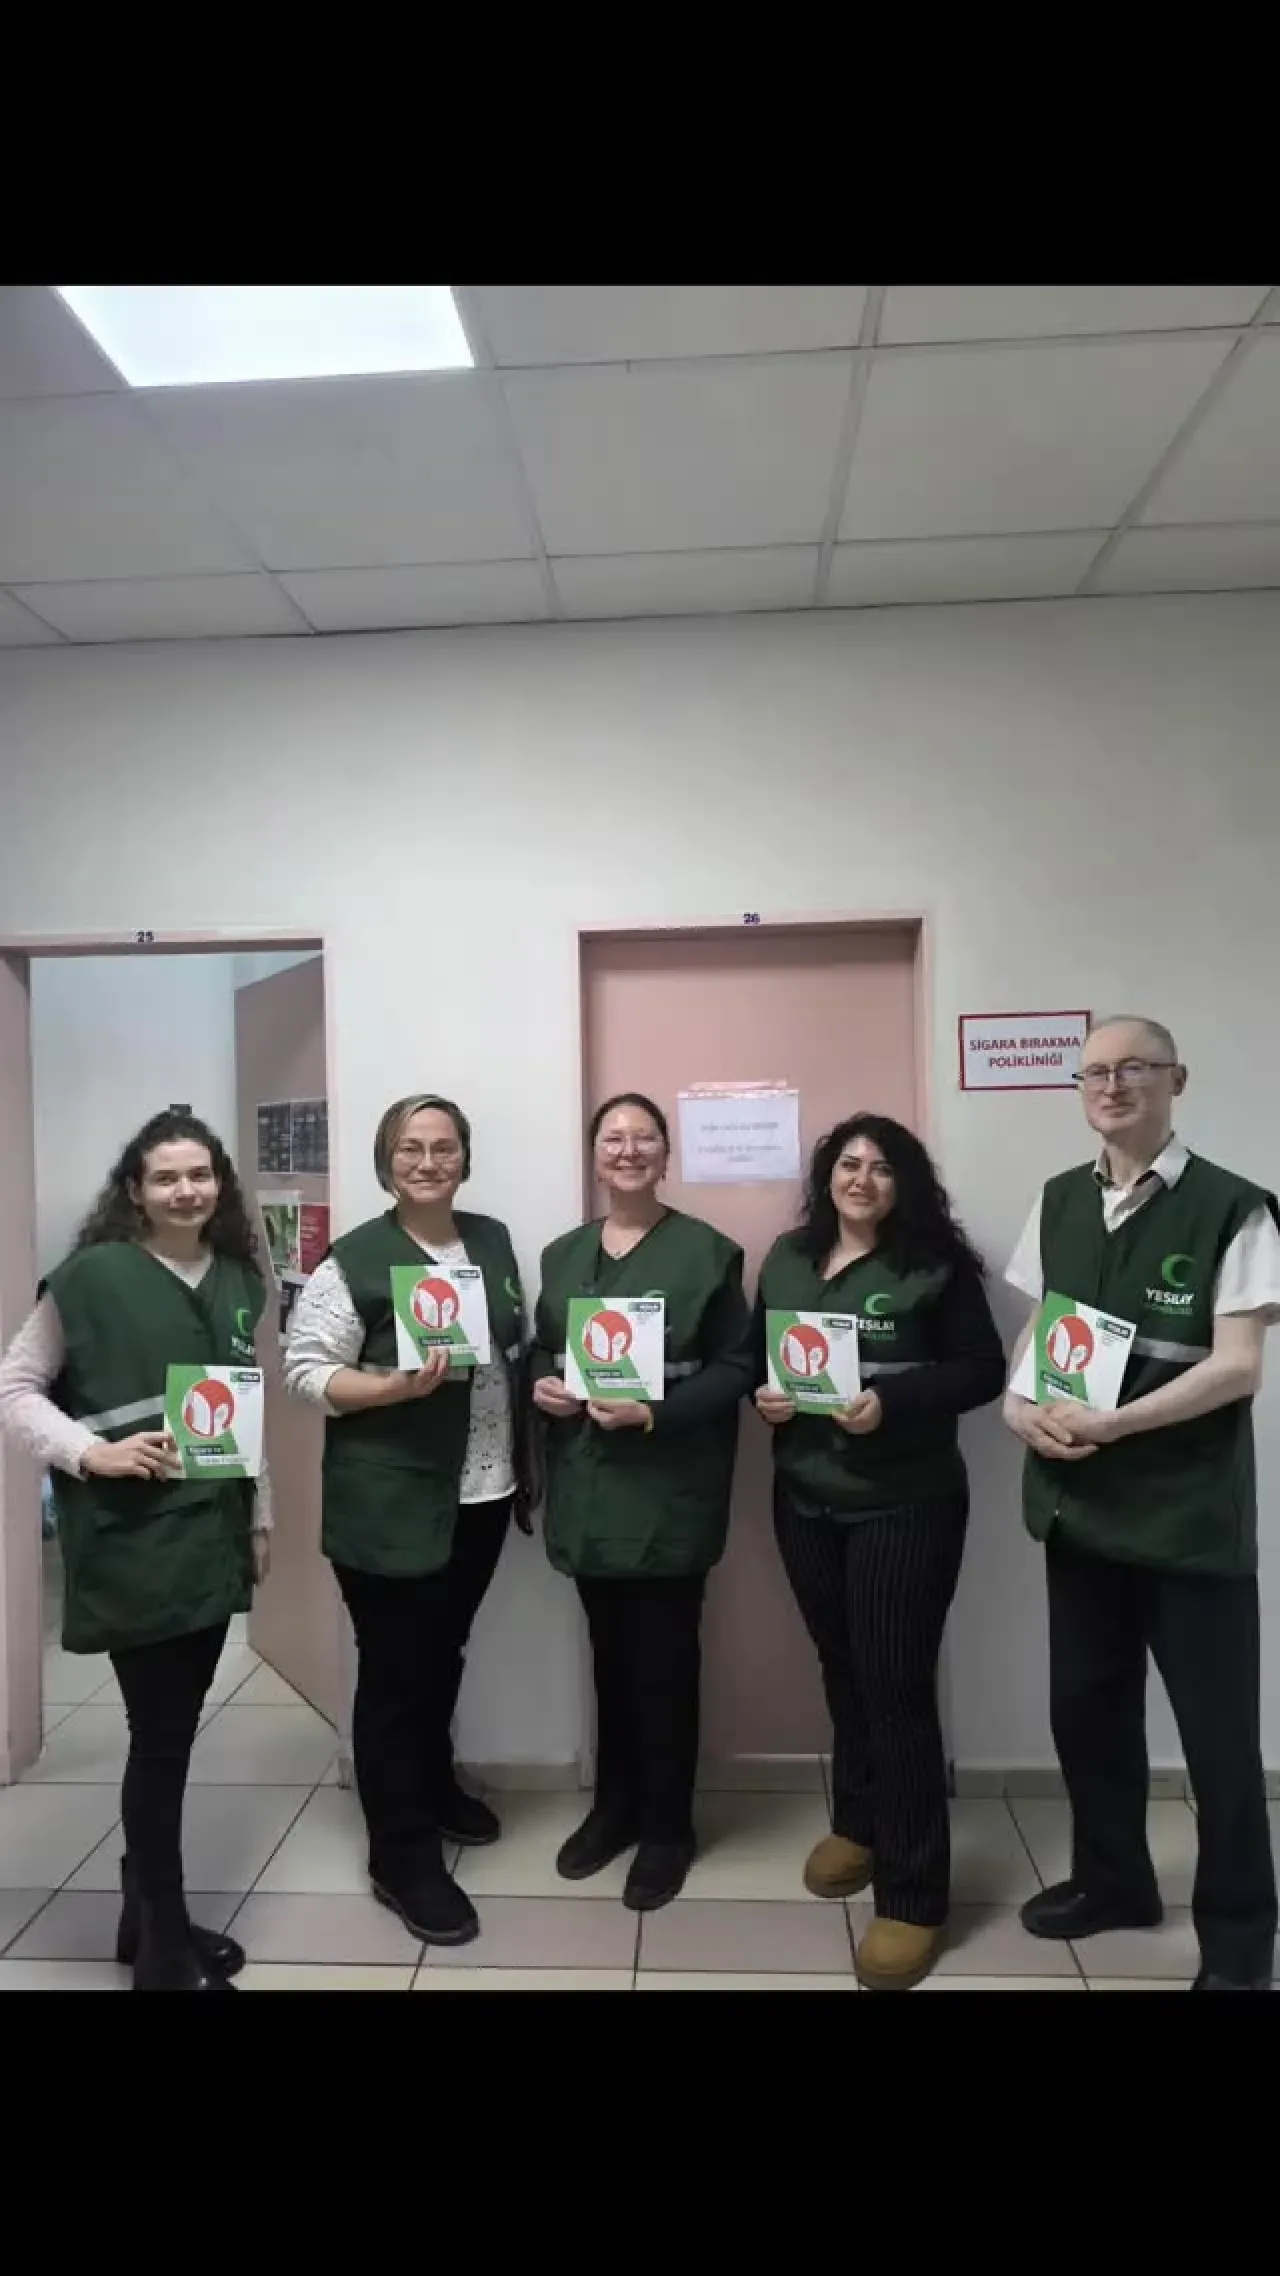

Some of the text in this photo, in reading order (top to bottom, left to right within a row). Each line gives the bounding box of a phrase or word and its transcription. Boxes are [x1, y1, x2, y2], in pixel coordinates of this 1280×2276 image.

[743, 911, 760, 925] 26
[136, 930, 154, 943] 25
[969, 1036, 1080, 1050] SİGARA BIRAKMA
[988, 1052, 1063, 1068] POLİKLİNİĞİ
